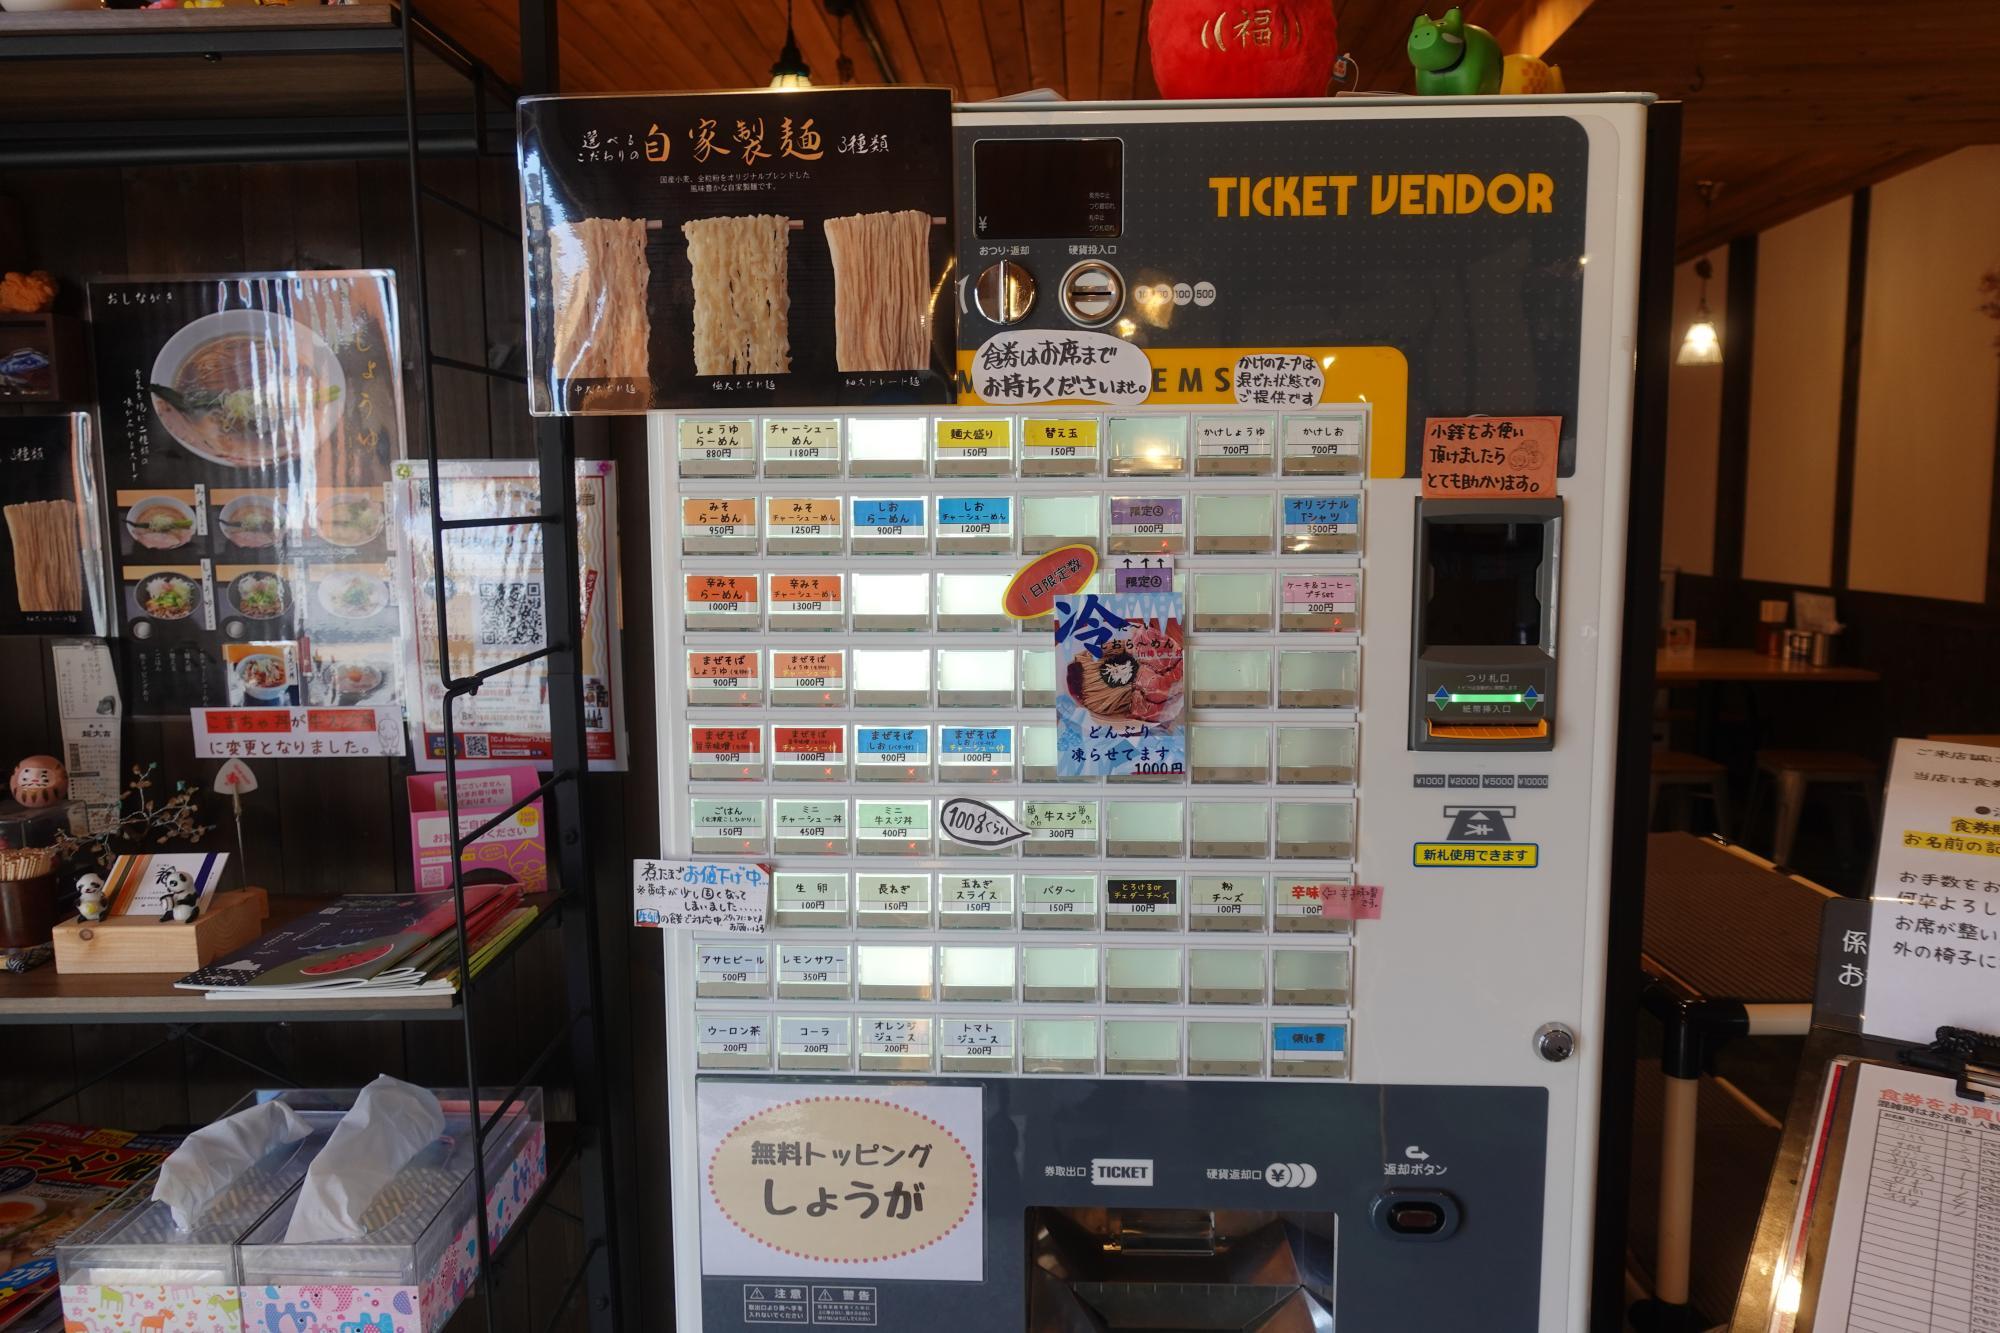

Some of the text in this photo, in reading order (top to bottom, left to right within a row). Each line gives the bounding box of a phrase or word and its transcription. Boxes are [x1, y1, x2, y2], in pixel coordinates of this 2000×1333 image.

[1233, 9, 1271, 48] 福
[582, 130, 634, 149] 選べる
[644, 117, 824, 165] 自家製麺
[837, 133, 890, 155] 3種類
[577, 150, 639, 163] こだわりの
[1208, 173, 1554, 217] TICKET VENDOR
[1068, 245, 1117, 255] 硬貨投入口
[1174, 288, 1213, 299] 100 500
[108, 292, 174, 305] おしながき
[981, 338, 1117, 370] 食券はお席まで
[1238, 356, 1316, 371] かけのスープは
[1236, 372, 1321, 389] 混ぜた状態での
[983, 373, 1147, 398] お持ちくださいませ。
[1239, 390, 1314, 406] ご提供です
[696, 424, 739, 434] しょうゆ
[770, 424, 835, 434] チャーシュー
[1045, 427, 1079, 439] 替え玉
[1204, 428, 1265, 437] かけしょうゆ
[1303, 428, 1344, 437] かけしお
[1431, 422, 1524, 440] 小銭をお使い
[951, 428, 993, 440] 麺大盛り
[696, 436, 739, 446] らーめん
[792, 437, 812, 446] めん
[706, 449, 731, 458] 880円
[789, 448, 819, 457] 1180円
[962, 447, 987, 457] 150円
[1050, 446, 1076, 456] 150円
[1223, 445, 1249, 454] 700円
[1311, 445, 1338, 454] 700円
[1430, 445, 1505, 465] 頂けましたら
[1427, 473, 1540, 493] とても助かります。
[709, 502, 729, 512] みそ
[793, 503, 813, 513] みそ
[878, 502, 898, 512] しお
[964, 502, 985, 511] しお
[1293, 501, 1349, 509] オリジナル
[699, 514, 741, 523] らーめん
[868, 515, 910, 524] らーめん
[943, 513, 1006, 521] チャーシューめん
[709, 526, 734, 535] 950円
[791, 525, 821, 534] 1250円
[877, 526, 902, 535] 900円
[961, 524, 991, 533] 1200円
[1134, 525, 1164, 534] 1000円
[1307, 524, 1338, 534] 3500円
[706, 578, 735, 588] 辛みそ
[790, 578, 820, 589] 辛みそ
[700, 590, 742, 600] らーめん
[1305, 591, 1334, 599] プチset
[709, 602, 738, 611] 1000円
[793, 602, 821, 611] 1300円
[1308, 603, 1334, 612] 200円
[1055, 594, 1131, 659] 冷
[703, 656, 745, 665] まぜそば
[792, 655, 827, 663] まぜそば
[713, 678, 737, 687] 900円
[796, 678, 825, 687] 1000円
[1466, 674, 1509, 683] つり札口
[1462, 704, 1511, 713] 紙幣挿入口
[705, 730, 747, 740] まぜそば
[792, 731, 827, 739] まぜそば
[871, 731, 914, 740] まぜそば
[955, 730, 997, 739] まぜそば
[1089, 726, 1152, 739] どんぶり
[210, 739, 369, 755] に変更となりました。
[715, 753, 740, 762] 900円
[796, 753, 825, 762] 1000円
[881, 753, 906, 762] 900円
[963, 753, 992, 762] 1000円
[1072, 747, 1170, 761] 凍らせてます
[1135, 762, 1183, 774] 1000円
[1416, 777, 1548, 785] ¥1000 ¥2000 ¥5000 ¥10000
[714, 807, 742, 815] ごはん
[803, 805, 819, 813] ミニ
[885, 806, 902, 814] ミニ
[780, 815, 842, 823] チャーシュー丼
[875, 816, 912, 825] 牛スジ丼
[1044, 811, 1077, 821] 牛スジ
[719, 828, 742, 836] 150円
[800, 828, 825, 836] 450円
[882, 829, 907, 837] 400円
[1049, 829, 1074, 838] 300円
[1424, 848, 1528, 861] 新札使用できます
[961, 878, 993, 889] 玉ねぎ
[1900, 871, 2000, 893] お手数をお
[877, 883, 911, 894] 長ねぎ
[1122, 883, 1162, 891] とろけるor
[1222, 883, 1233, 891] 粉
[956, 891, 998, 900] スライス
[801, 901, 825, 909] 100円
[884, 902, 908, 910] 150円
[966, 903, 991, 911] 150円
[1049, 903, 1073, 912] 150円
[1131, 904, 1156, 913] 100円
[1217, 905, 1241, 914] 100円
[1896, 915, 1997, 941] お席が整い
[1893, 941, 1997, 968] 外の椅子に
[702, 955, 764, 965] アサヒビール
[783, 955, 844, 965] レモンサワー
[722, 973, 747, 981] 500円
[803, 973, 827, 981] 350円
[874, 1021, 916, 1030] オレンジ
[964, 1023, 993, 1032] トマト
[708, 1026, 761, 1036] ウーロン茶
[800, 1027, 829, 1037] コーラ
[875, 1033, 916, 1042] ジュース
[958, 1035, 999, 1044] ジュース
[1291, 1032, 1327, 1044] 領収書
[723, 1043, 747, 1052] 200円
[804, 1044, 828, 1053] 200円
[884, 1044, 909, 1053] 200円
[967, 1046, 992, 1055] 200円
[751, 1141, 933, 1168] 無料トッピング
[1045, 1166, 1086, 1177] 券取出口
[1098, 1165, 1149, 1179] TICKET
[1206, 1168, 1262, 1180] 硬貨返却口
[1384, 1163, 1447, 1176] 返却ボタン
[764, 1178, 926, 1219] しょうが
[775, 1288, 801, 1299] 注意
